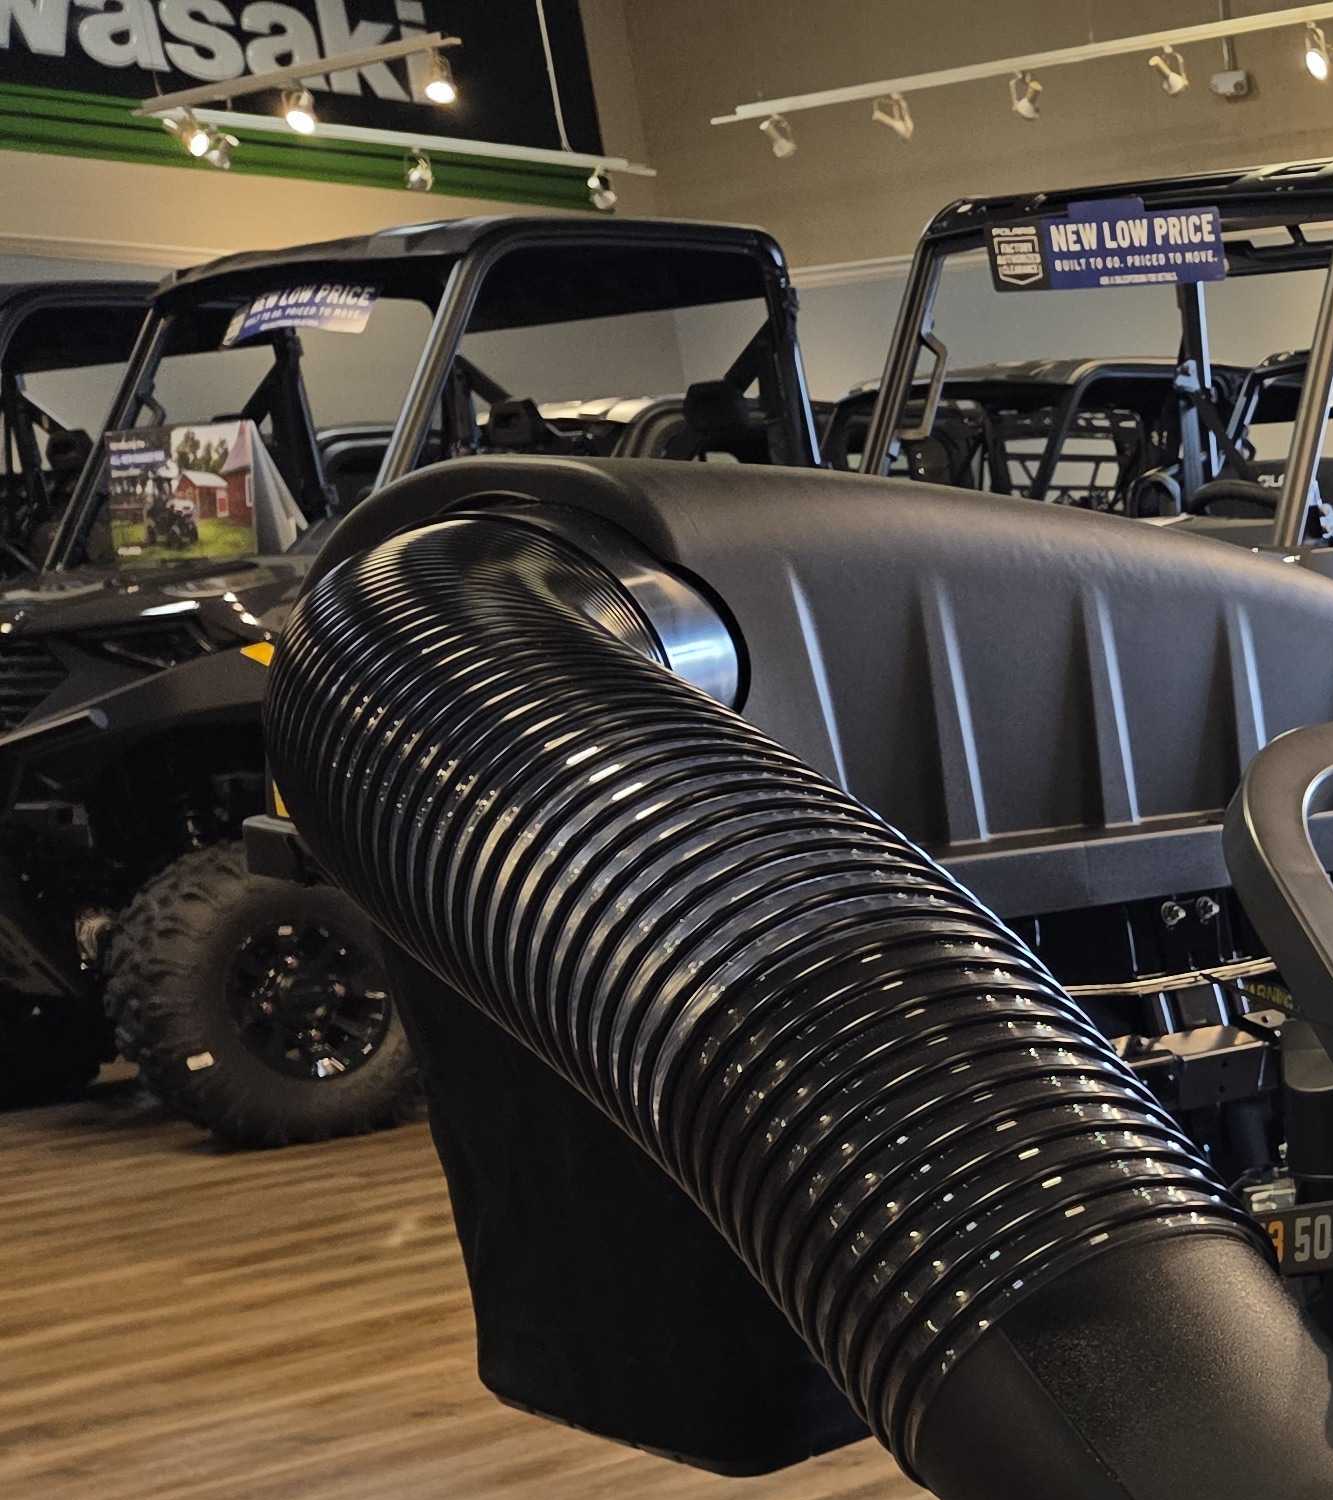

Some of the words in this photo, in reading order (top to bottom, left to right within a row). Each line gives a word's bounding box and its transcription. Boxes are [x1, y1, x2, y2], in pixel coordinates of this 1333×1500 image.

[1050, 222, 1098, 253] NEW
[1103, 218, 1149, 250] LOW
[1154, 213, 1216, 246] PRICE
[1055, 257, 1087, 272] BUILT
[1090, 257, 1104, 270] TO
[1106, 255, 1124, 269] GO.
[1127, 254, 1166, 268] PRICED
[1169, 252, 1183, 265] TO
[1185, 250, 1218, 264] MOVE.
[315, 284, 376, 307] PRICE
[1294, 1213, 1333, 1263] 50
